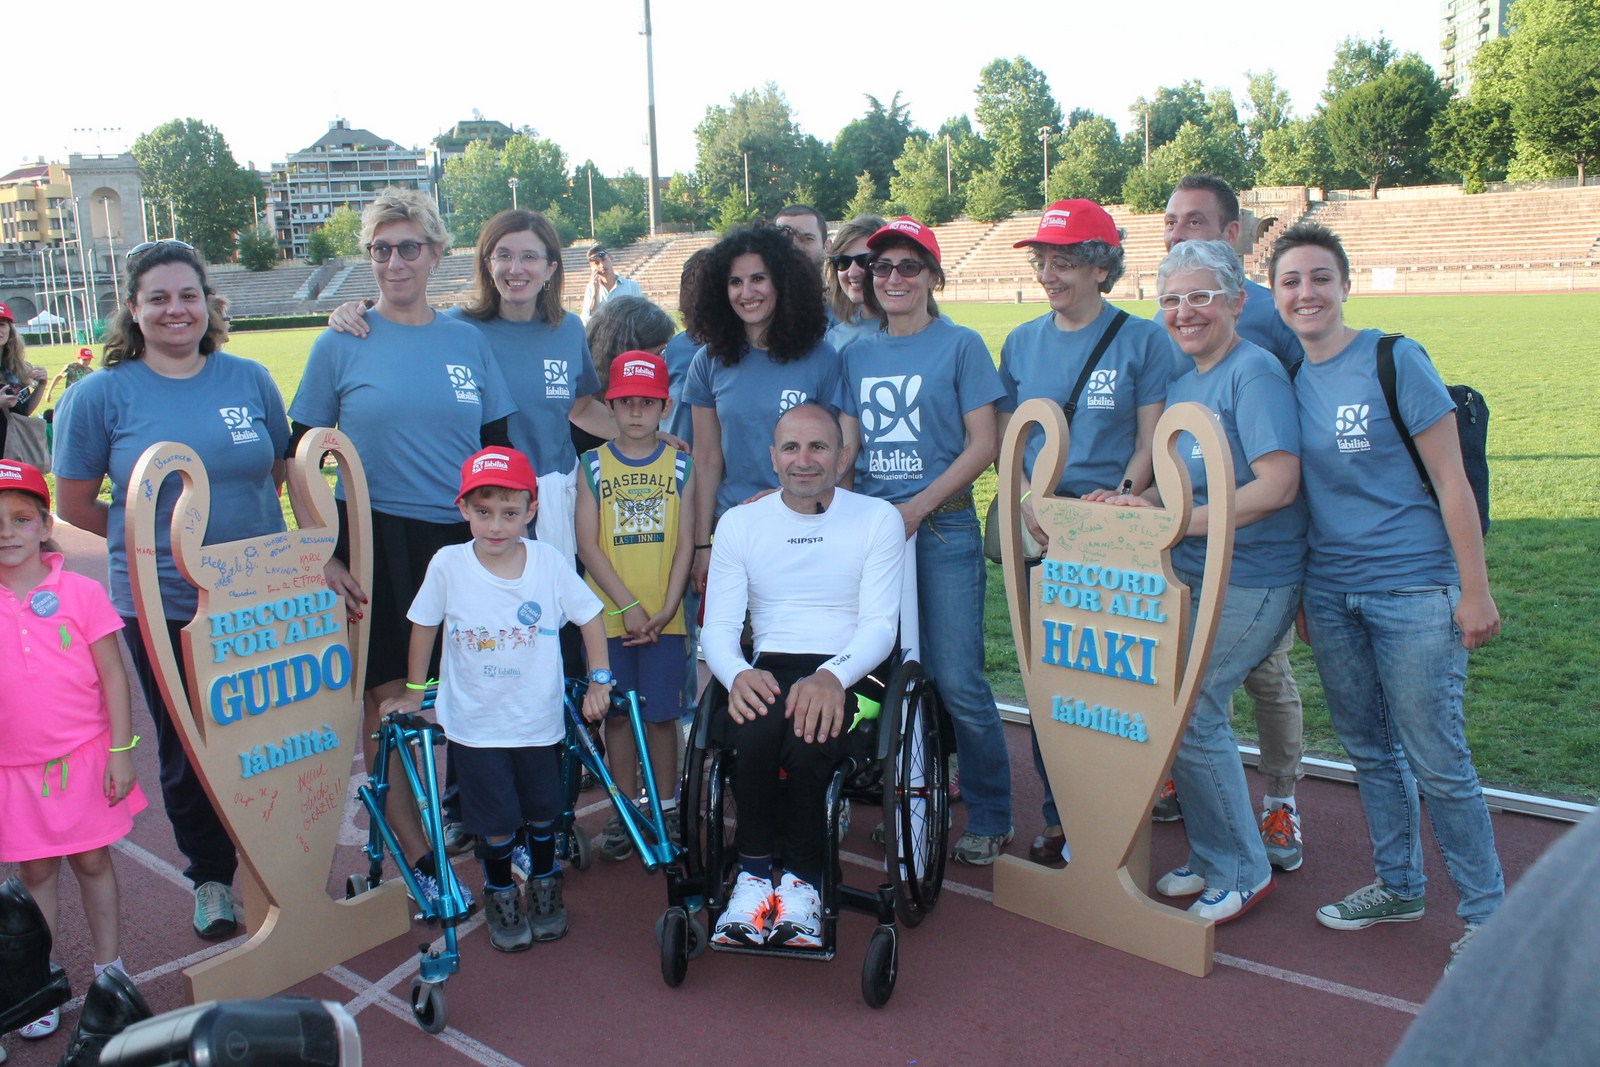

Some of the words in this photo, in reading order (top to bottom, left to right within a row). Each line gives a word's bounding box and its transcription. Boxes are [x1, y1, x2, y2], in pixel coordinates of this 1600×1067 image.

[601, 473, 676, 499] BASEBALL
[614, 535, 635, 545] LAST
[1041, 558, 1167, 597] RECORD
[208, 589, 338, 638] RECORD
[1041, 582, 1103, 613] FOR
[1107, 594, 1167, 623] ALL
[212, 628, 280, 663] FOR
[284, 613, 341, 645] ALL
[1042, 619, 1160, 685] HAKI
[207, 643, 352, 726] GUIDO
